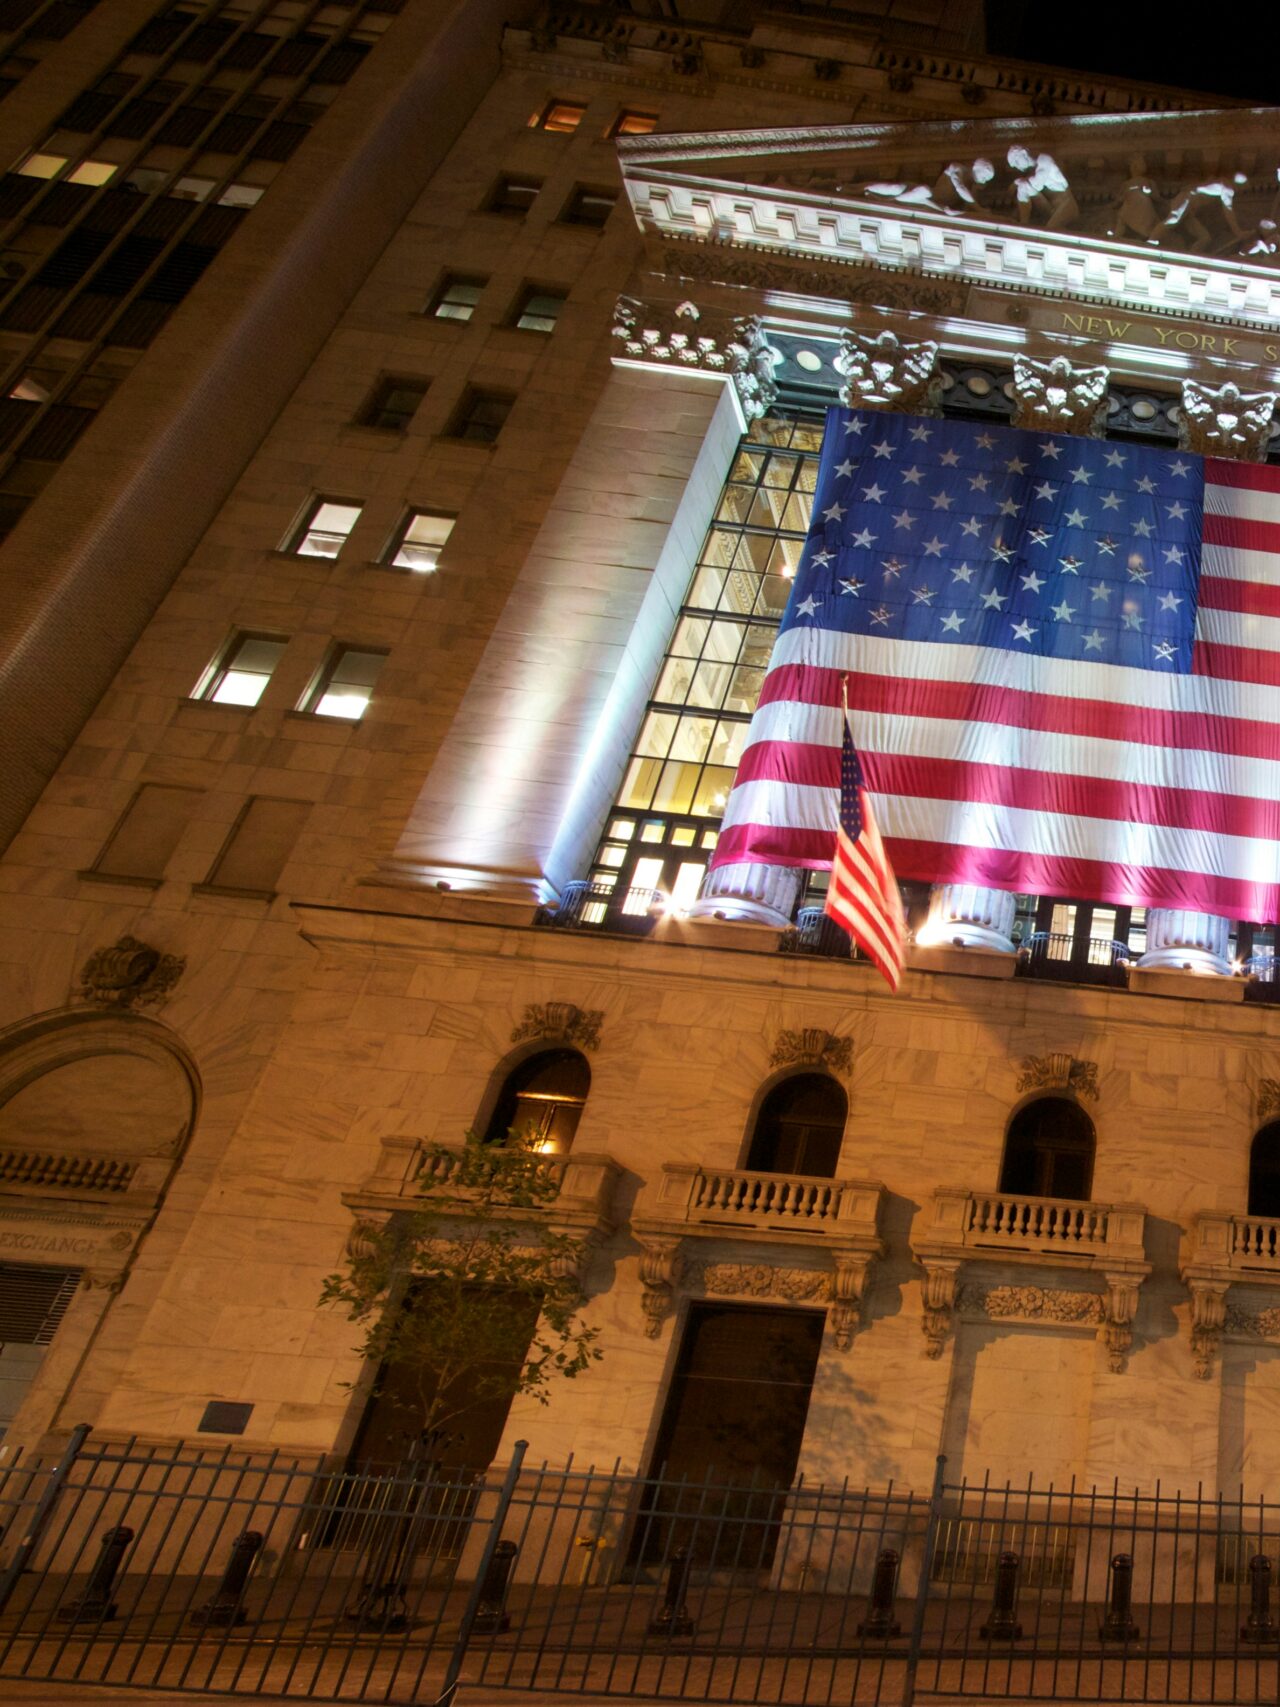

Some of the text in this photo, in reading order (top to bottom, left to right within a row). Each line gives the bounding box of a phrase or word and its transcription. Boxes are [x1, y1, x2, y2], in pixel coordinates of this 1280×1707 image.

[1061, 312, 1132, 338] NEW
[1154, 326, 1240, 356] YORK
[0, 1231, 99, 1254] EXCHANGE
